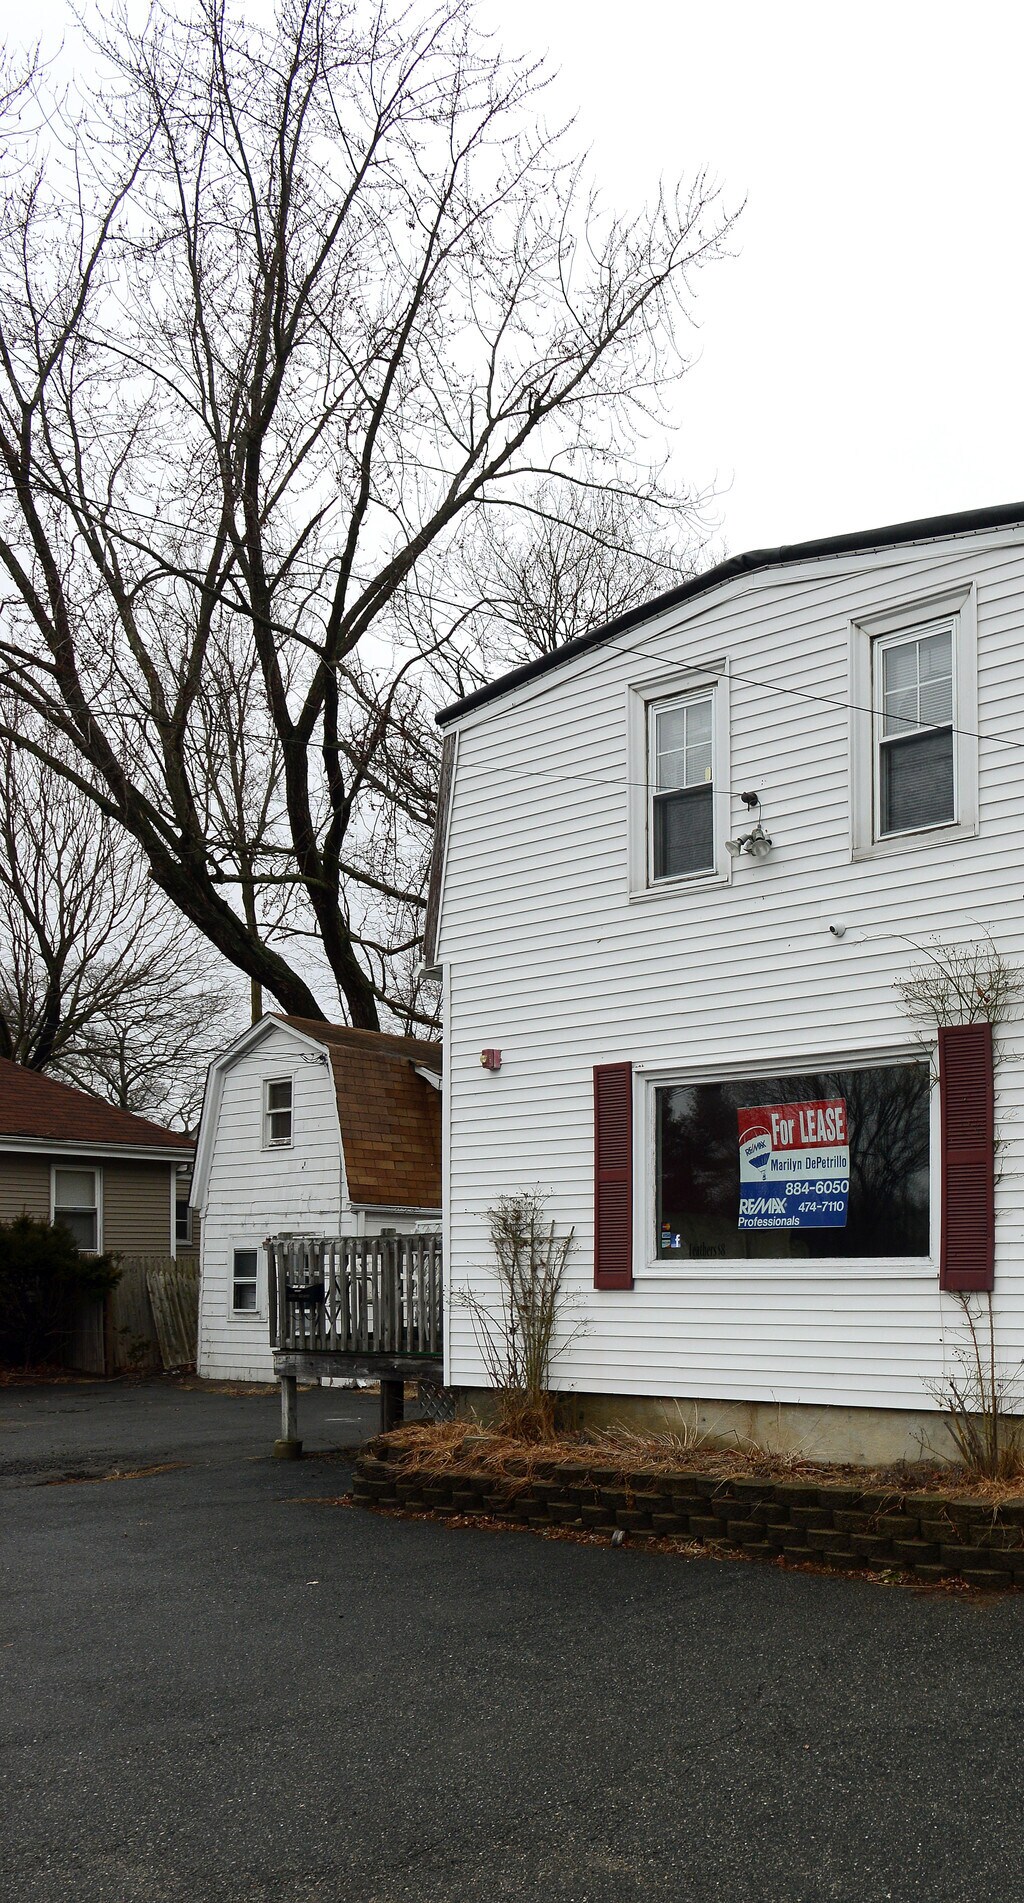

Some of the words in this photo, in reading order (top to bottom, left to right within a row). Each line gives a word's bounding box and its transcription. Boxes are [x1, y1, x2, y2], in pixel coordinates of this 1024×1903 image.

[771, 1113, 795, 1146] For
[799, 1107, 846, 1144] LEASE
[744, 1140, 767, 1157] RE/MAX
[771, 1158, 802, 1172] Marilyn
[806, 1156, 847, 1170] DePetrillo
[785, 1180, 850, 1195] 884-6050
[739, 1197, 787, 1215] RE/MAX
[798, 1201, 844, 1213] 474-7110
[737, 1215, 800, 1227] Professionals
